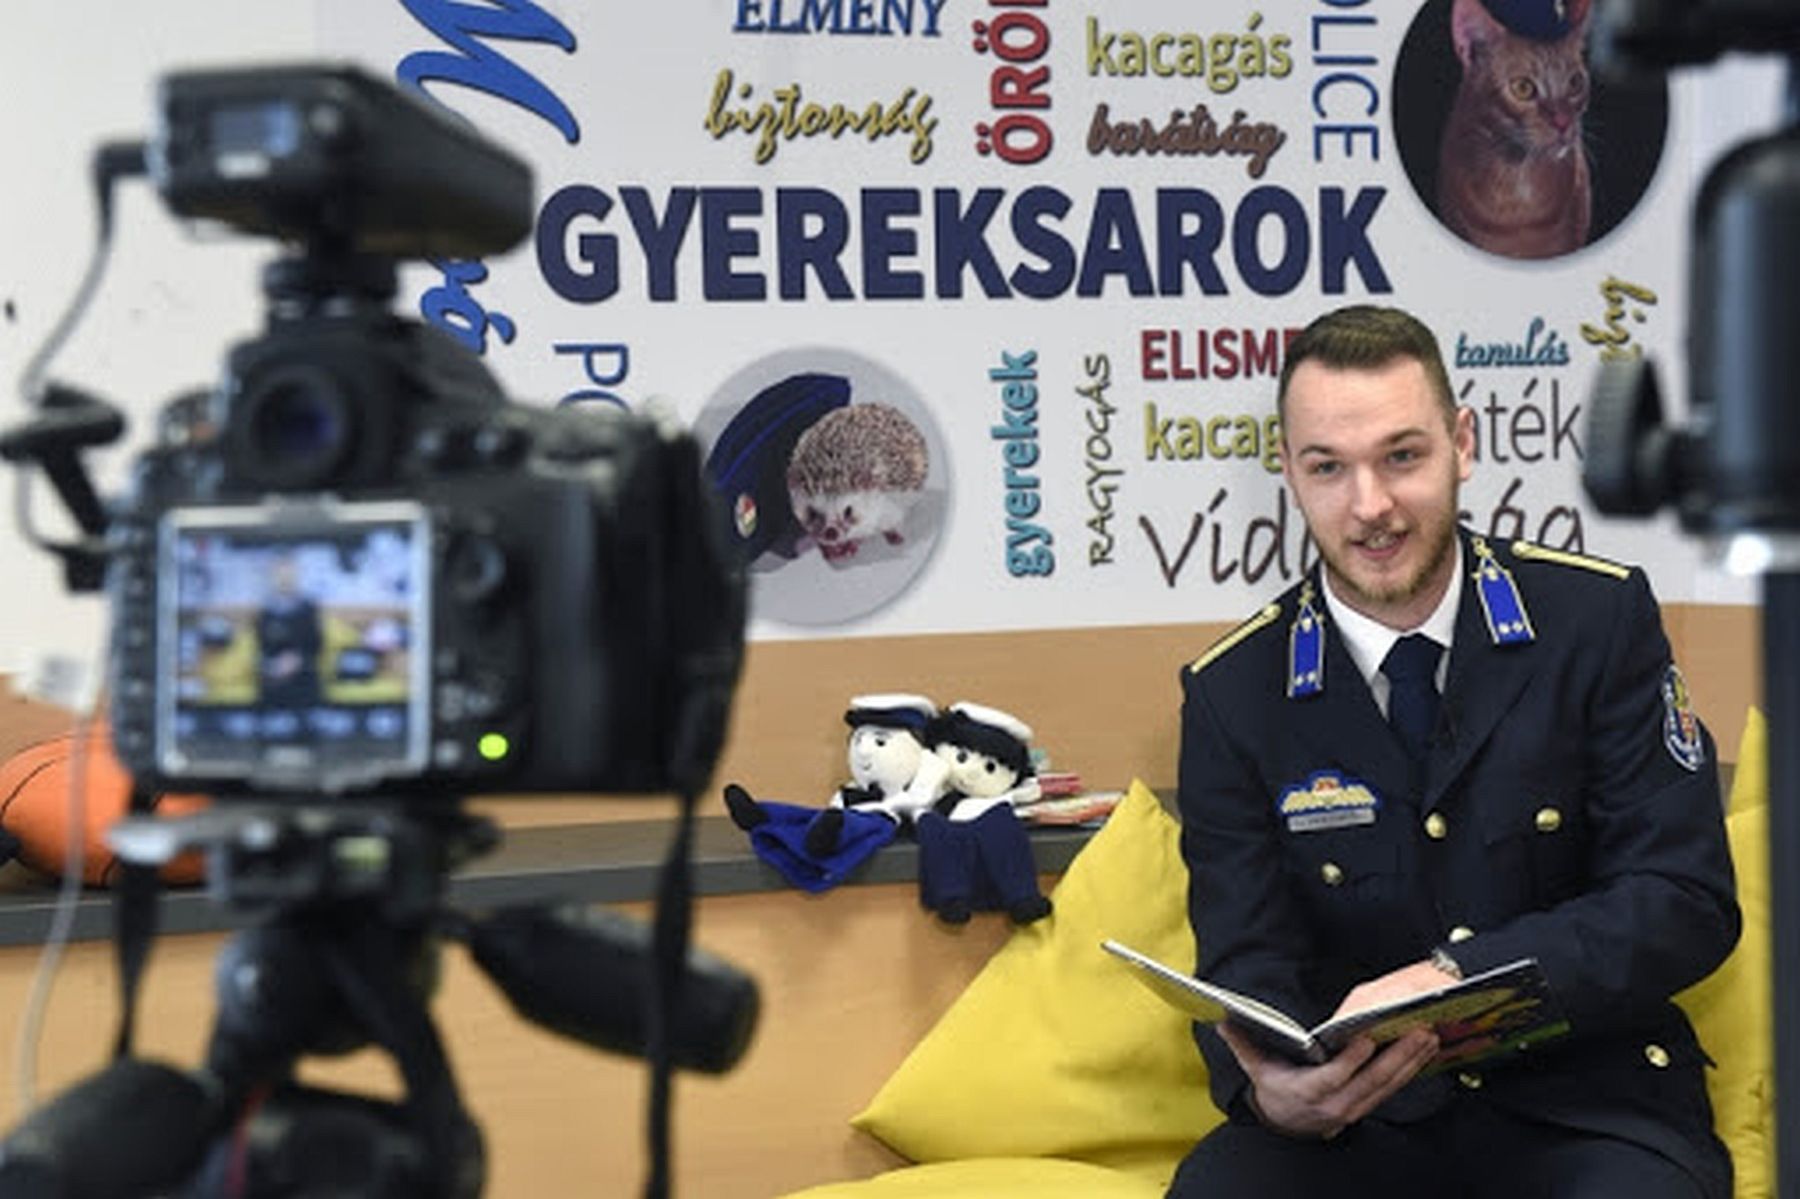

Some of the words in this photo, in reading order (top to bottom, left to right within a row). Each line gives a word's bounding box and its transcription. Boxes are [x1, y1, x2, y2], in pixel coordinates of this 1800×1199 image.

[1086, 12, 1293, 94] kacagás
[1311, 0, 1380, 162] LICE
[704, 68, 938, 164] biztonság
[1086, 103, 1287, 179] barátság
[536, 184, 1393, 304] GYEREKSAROK
[1455, 316, 1571, 368] tanulás
[988, 350, 1055, 578] gyerekek
[1075, 353, 1125, 567] RAGYOGÁS
[1144, 402, 1284, 475] kacag
